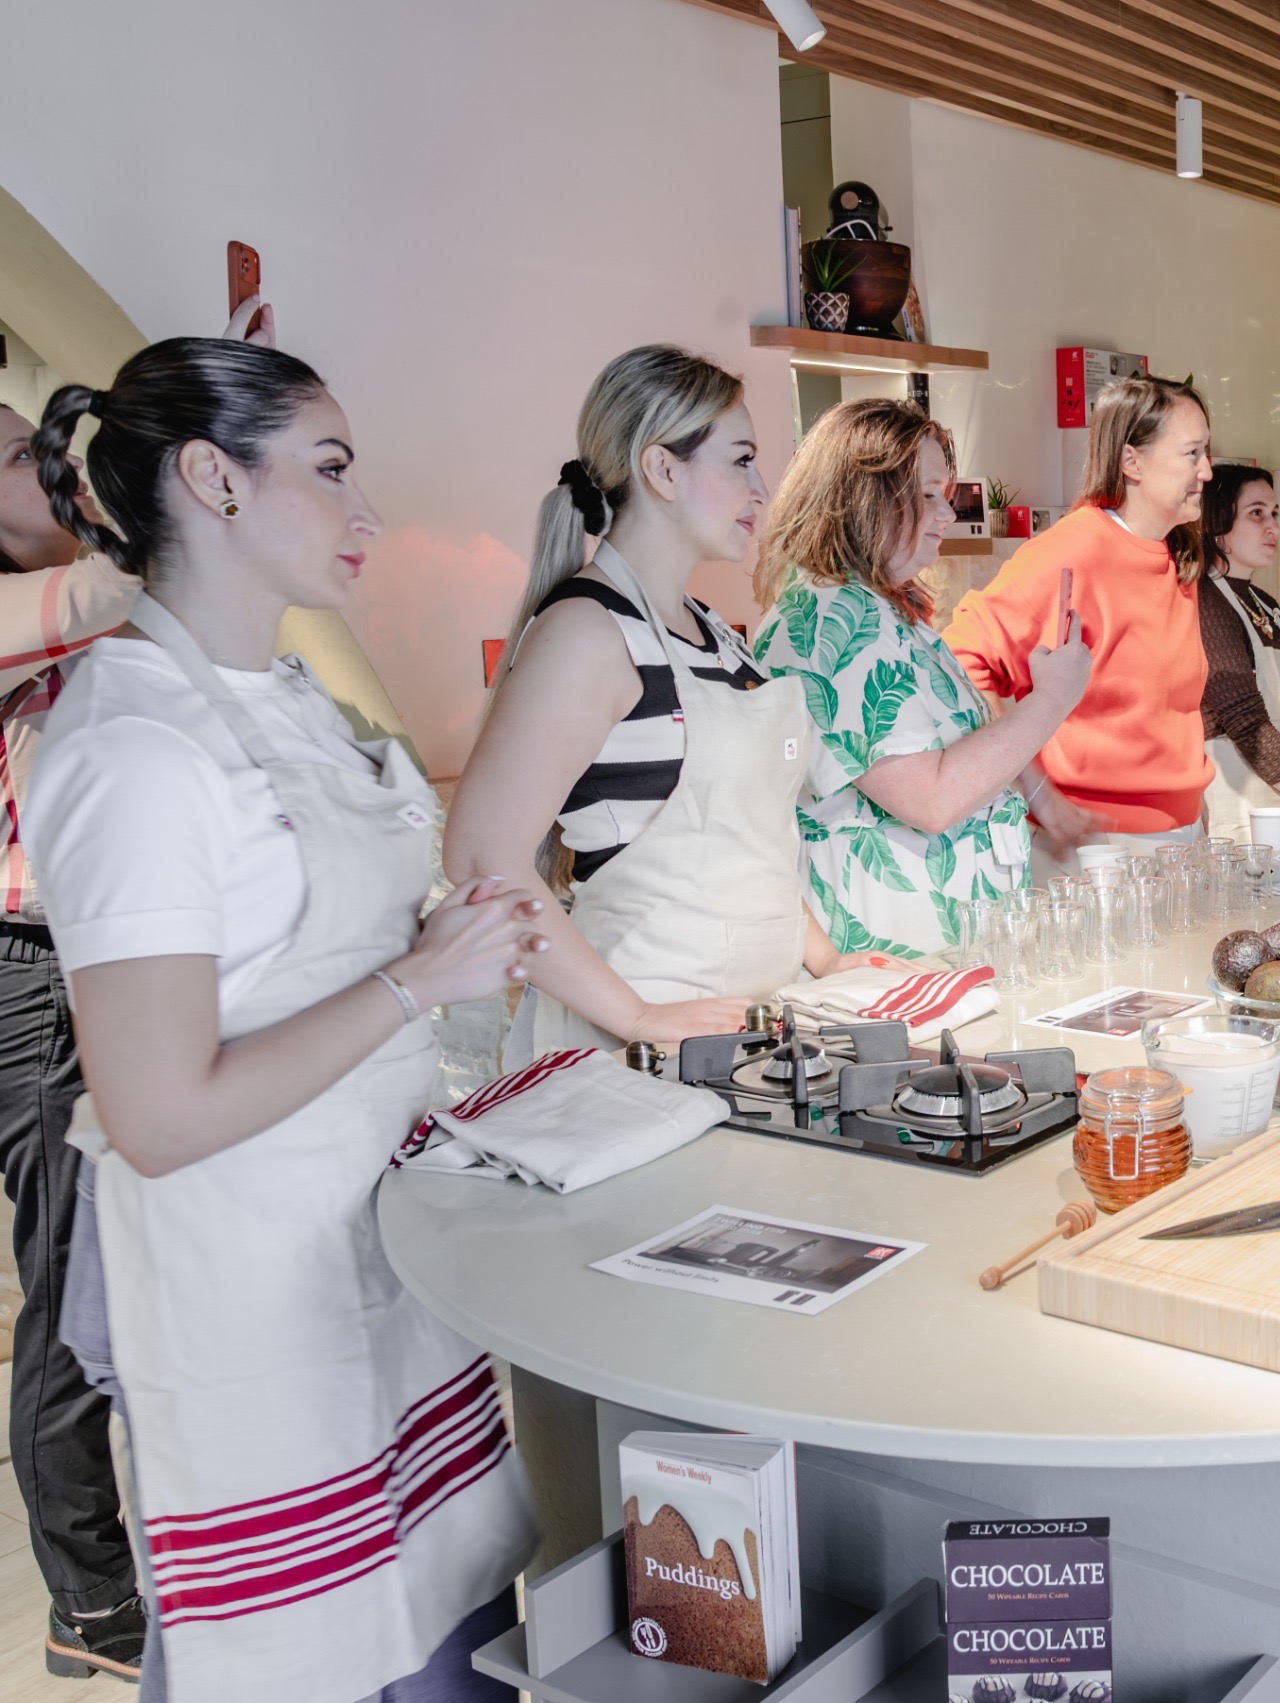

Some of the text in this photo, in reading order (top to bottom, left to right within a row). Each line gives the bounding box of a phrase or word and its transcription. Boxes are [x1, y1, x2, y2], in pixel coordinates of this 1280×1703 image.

[622, 1258, 653, 1270] Power
[654, 1266, 693, 1278] without
[656, 1459, 712, 1485] Women's Weekly
[969, 1521, 1088, 1535] CHOCOLATE
[645, 1556, 740, 1600] Puddings
[951, 1562, 1104, 1588] CHOCOLATE
[953, 1627, 1106, 1653] CHOCOLATE
